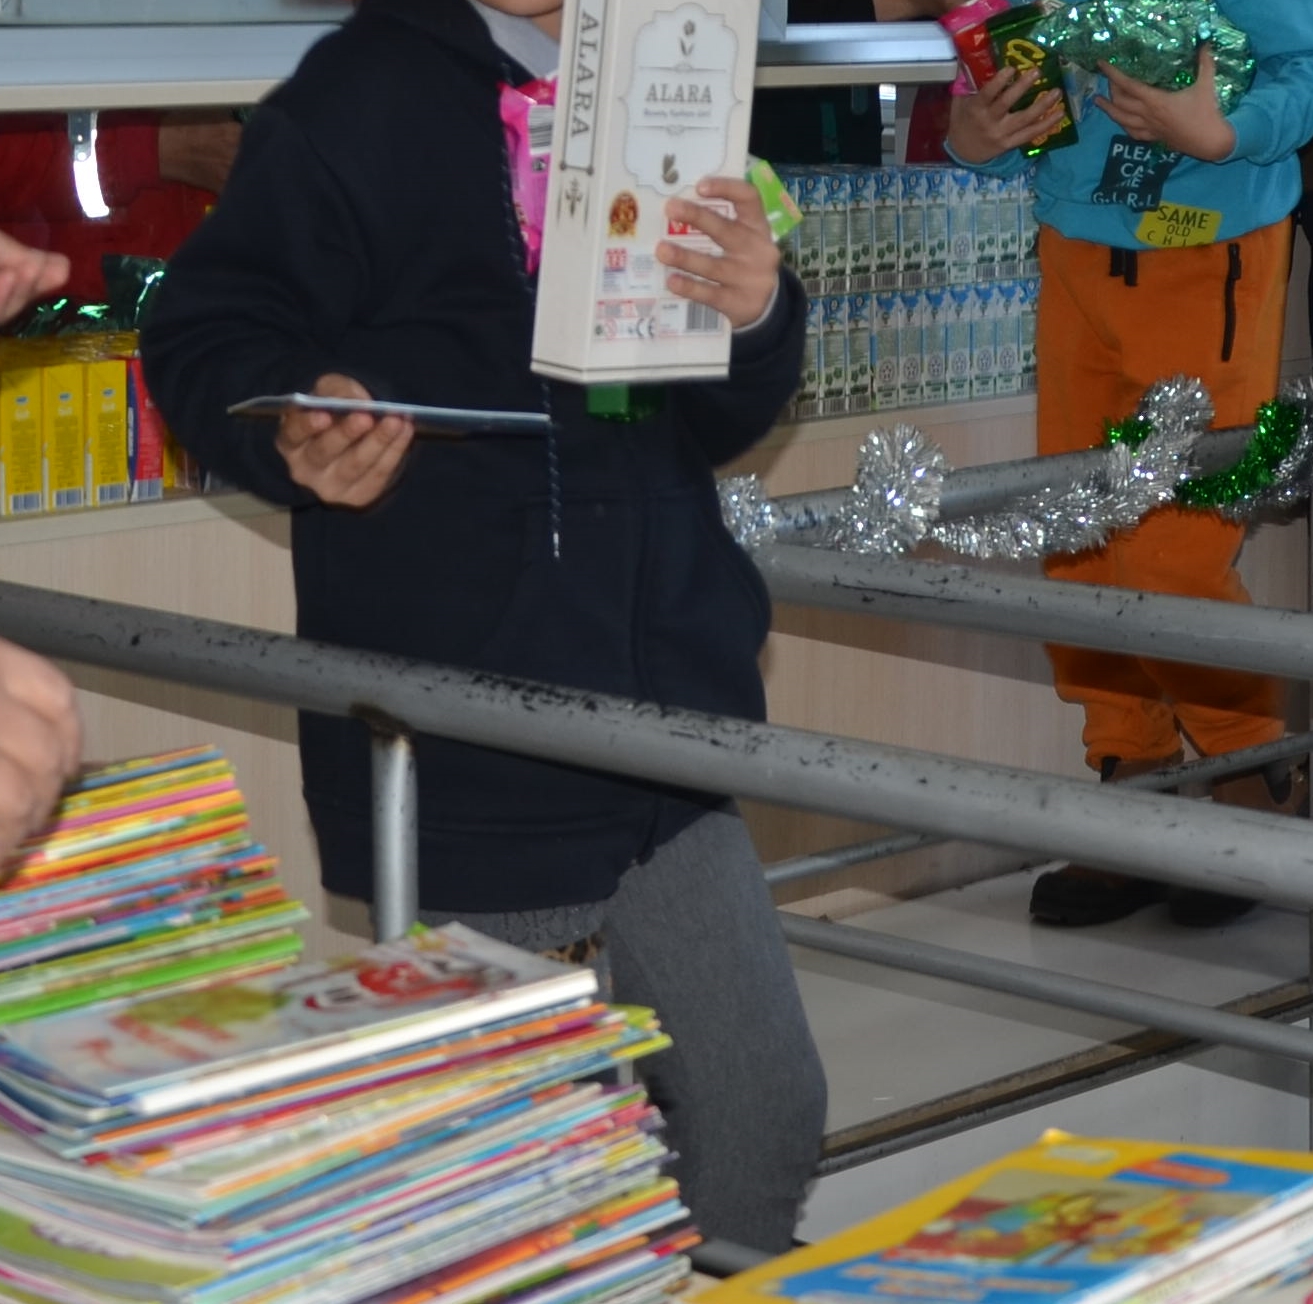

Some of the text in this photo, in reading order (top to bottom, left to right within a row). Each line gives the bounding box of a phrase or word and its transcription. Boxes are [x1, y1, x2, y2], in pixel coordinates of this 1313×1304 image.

[571, 11, 600, 138] ALARA
[644, 83, 714, 104] ALARA
[1157, 205, 1211, 230] SAME
[1166, 223, 1192, 238] OLD
